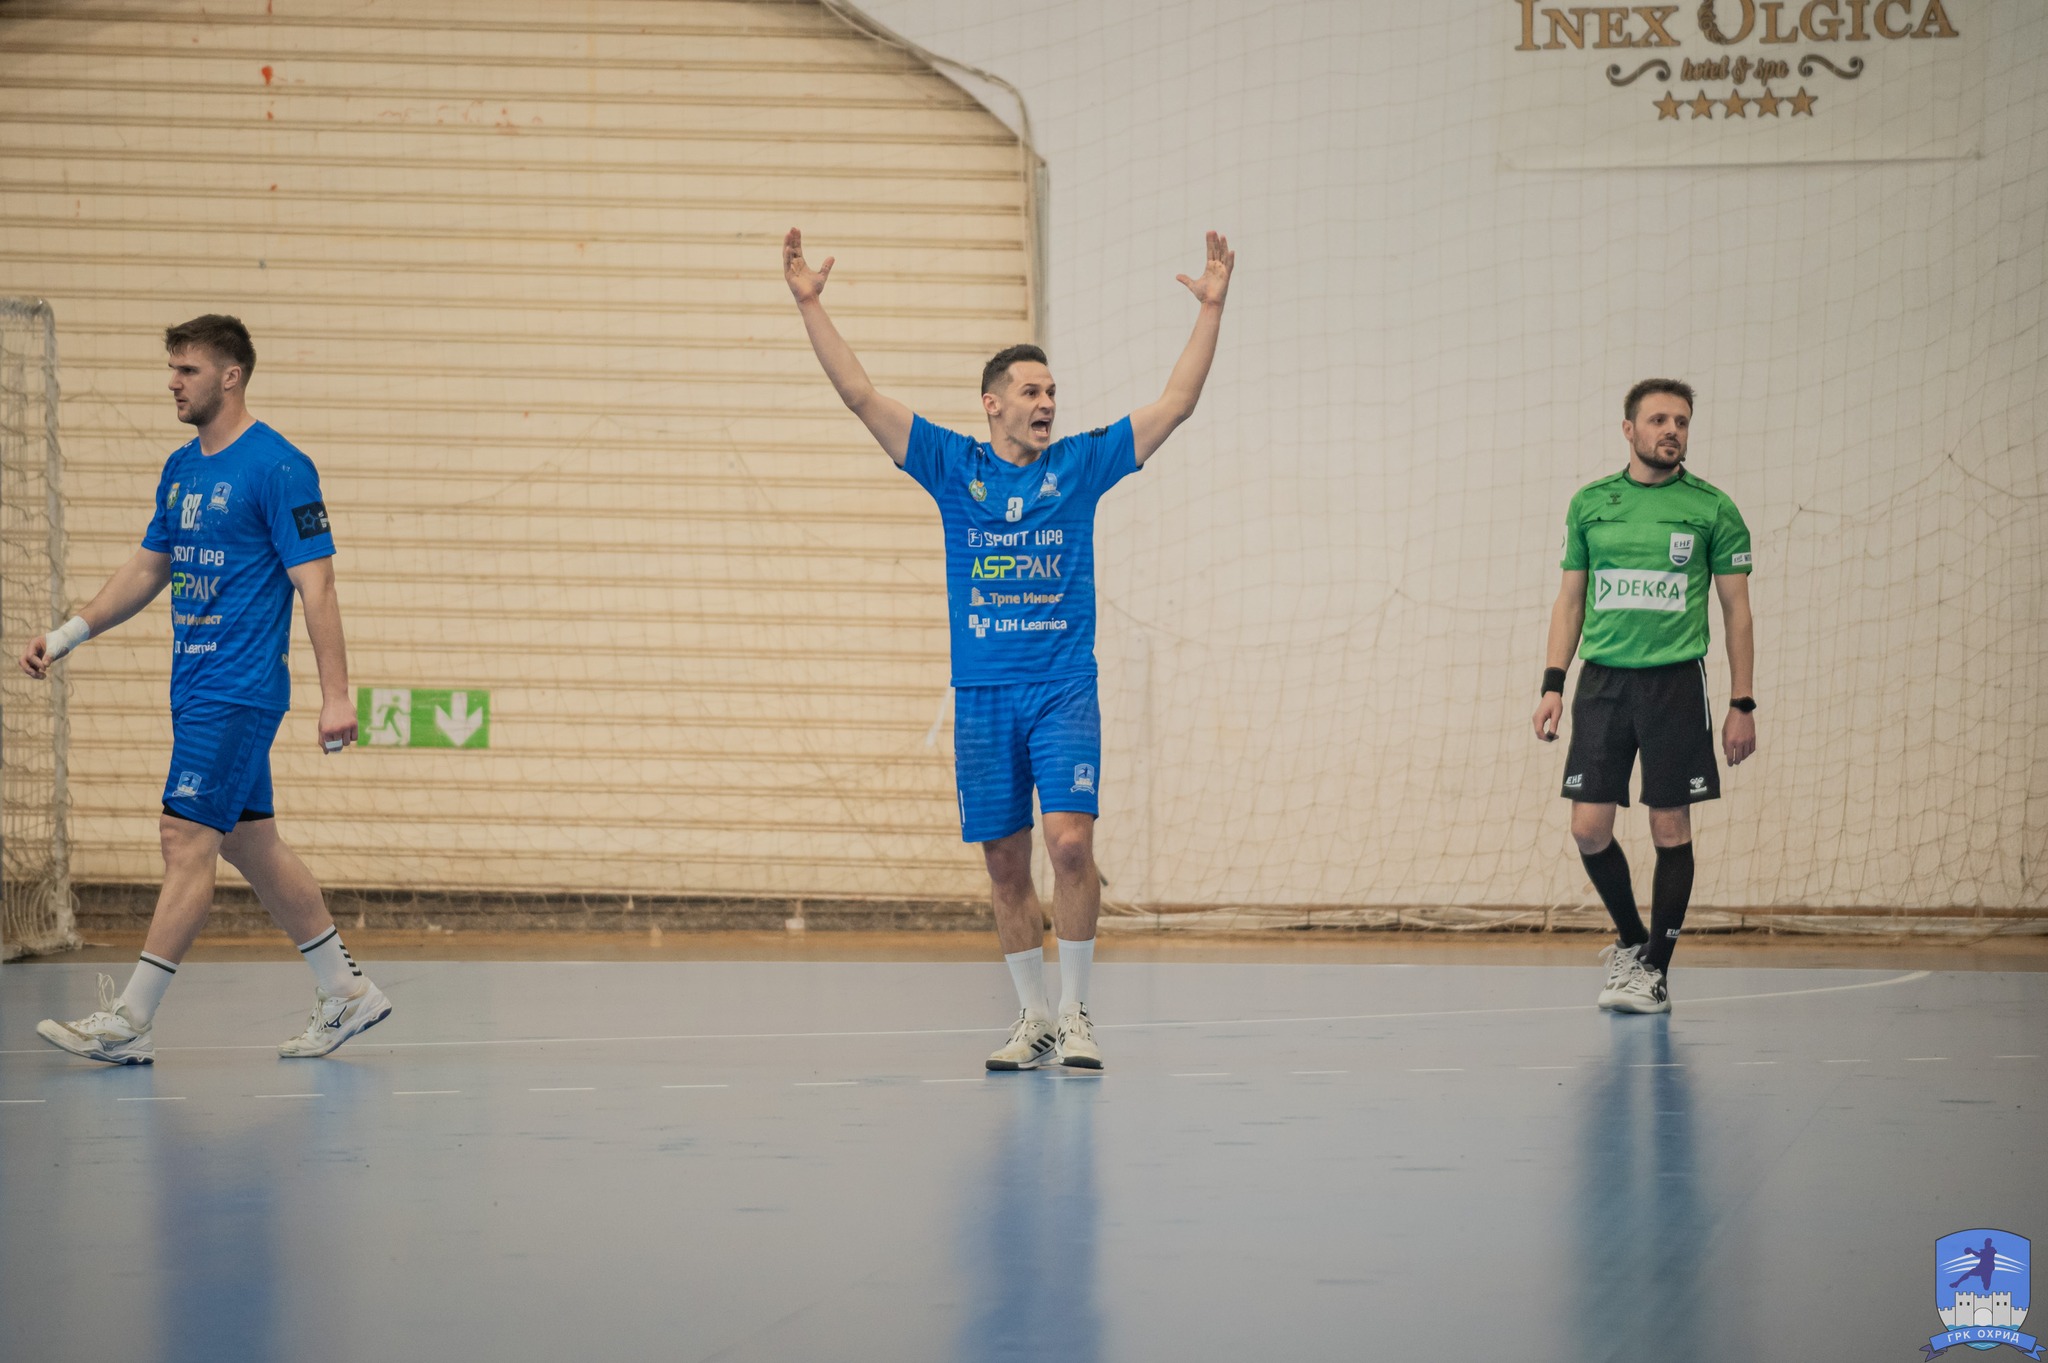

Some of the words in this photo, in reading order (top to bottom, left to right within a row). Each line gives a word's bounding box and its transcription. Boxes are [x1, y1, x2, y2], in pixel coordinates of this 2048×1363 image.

[1514, 0, 1681, 50] INEX
[1697, 0, 1959, 45] OLGICA
[1731, 55, 1754, 85] &
[181, 493, 203, 529] 87
[1006, 497, 1024, 523] 3
[1674, 540, 1691, 548] EHF
[971, 554, 1062, 579] ASPPAK
[1617, 578, 1680, 600] DEKRA
[995, 618, 1018, 632] LTH
[1565, 774, 1583, 785] EHF
